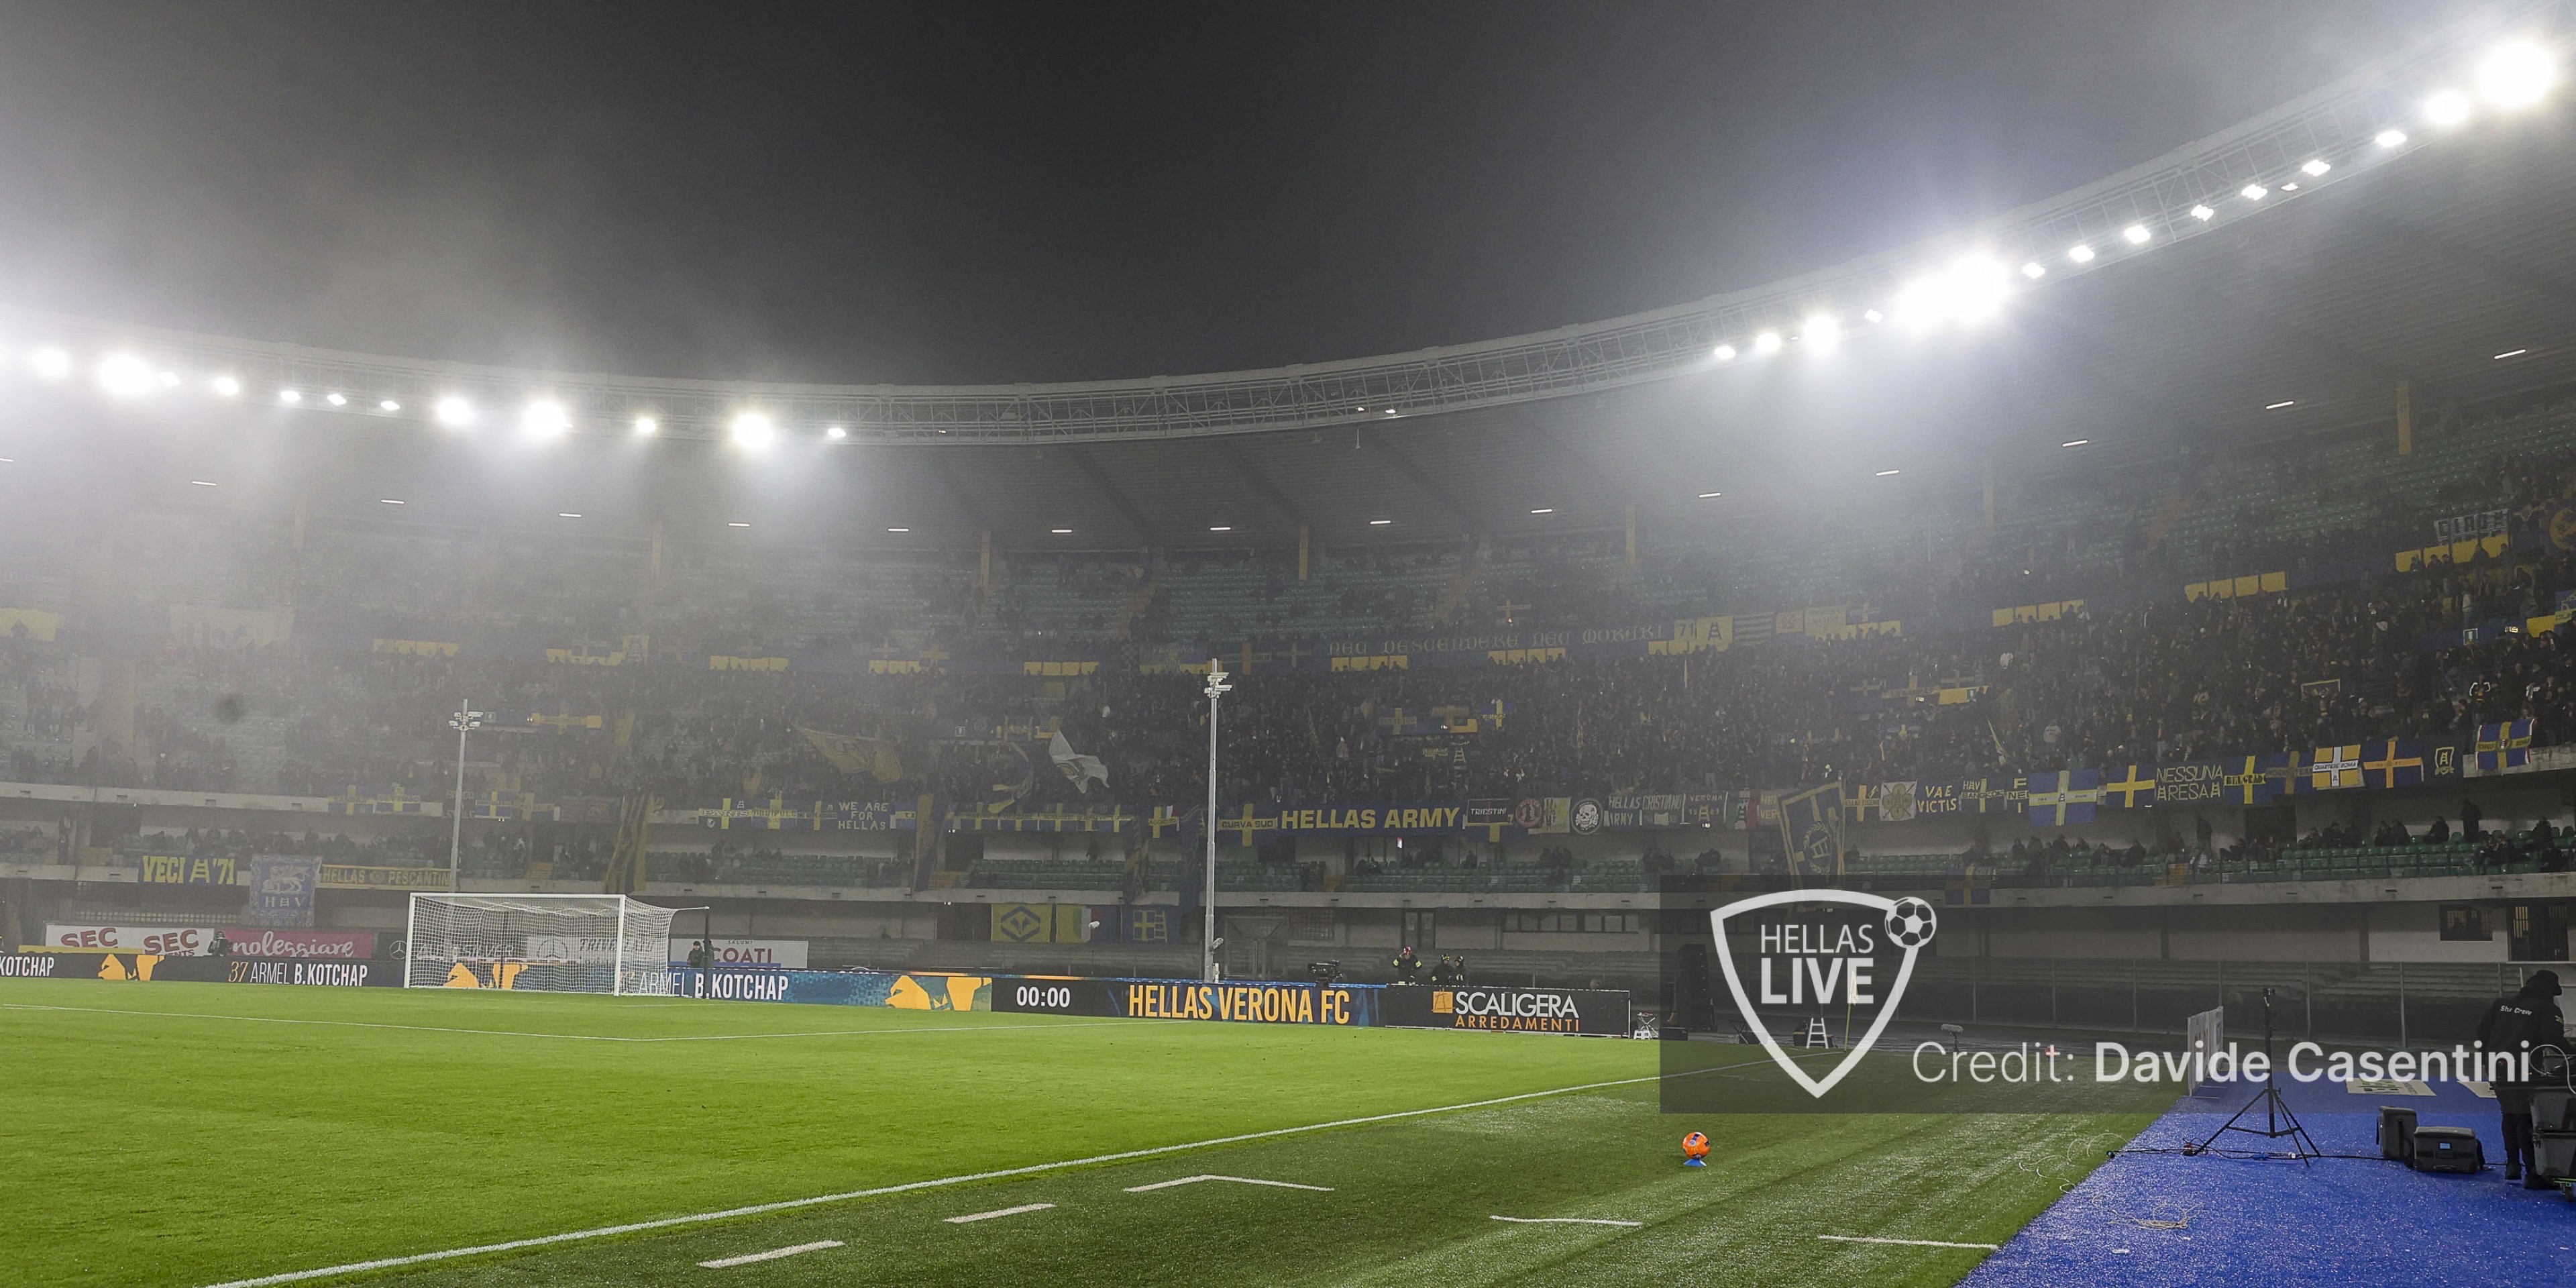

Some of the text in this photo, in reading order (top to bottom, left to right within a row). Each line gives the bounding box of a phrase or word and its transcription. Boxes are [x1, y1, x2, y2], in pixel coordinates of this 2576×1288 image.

[2156, 765, 2223, 784] NESSUNA
[1689, 794, 1722, 802] VERONA
[1925, 786, 1952, 797] VAE
[839, 802, 888, 812] WE ARE
[1609, 796, 1641, 809] HELLAS
[1917, 799, 1957, 812] VICTIS
[851, 811, 873, 820] FOR
[1255, 819, 1273, 828] SUD
[1281, 807, 1460, 830] HELLAS ARMY
[839, 820, 885, 831] HELLAS
[143, 856, 235, 885] VECI '71
[323, 871, 450, 886] HELLAS PESCANTIN
[61, 928, 118, 948] SEC
[143, 930, 199, 955] SEC
[231, 931, 354, 957] noleggiare
[713, 948, 771, 963] COATI
[229, 961, 368, 987] 37 ARMEL B.KOTCHAP
[639, 973, 689, 998] ARMEL
[695, 973, 789, 1000] B.KOTCHAP
[1016, 986, 1071, 1008] 00:00
[1129, 985, 1350, 1024] HELLAS VERONA FC
[1456, 991, 1579, 1018] SCALIGERA
[1455, 1014, 1579, 1032] ARREDAMENTI
